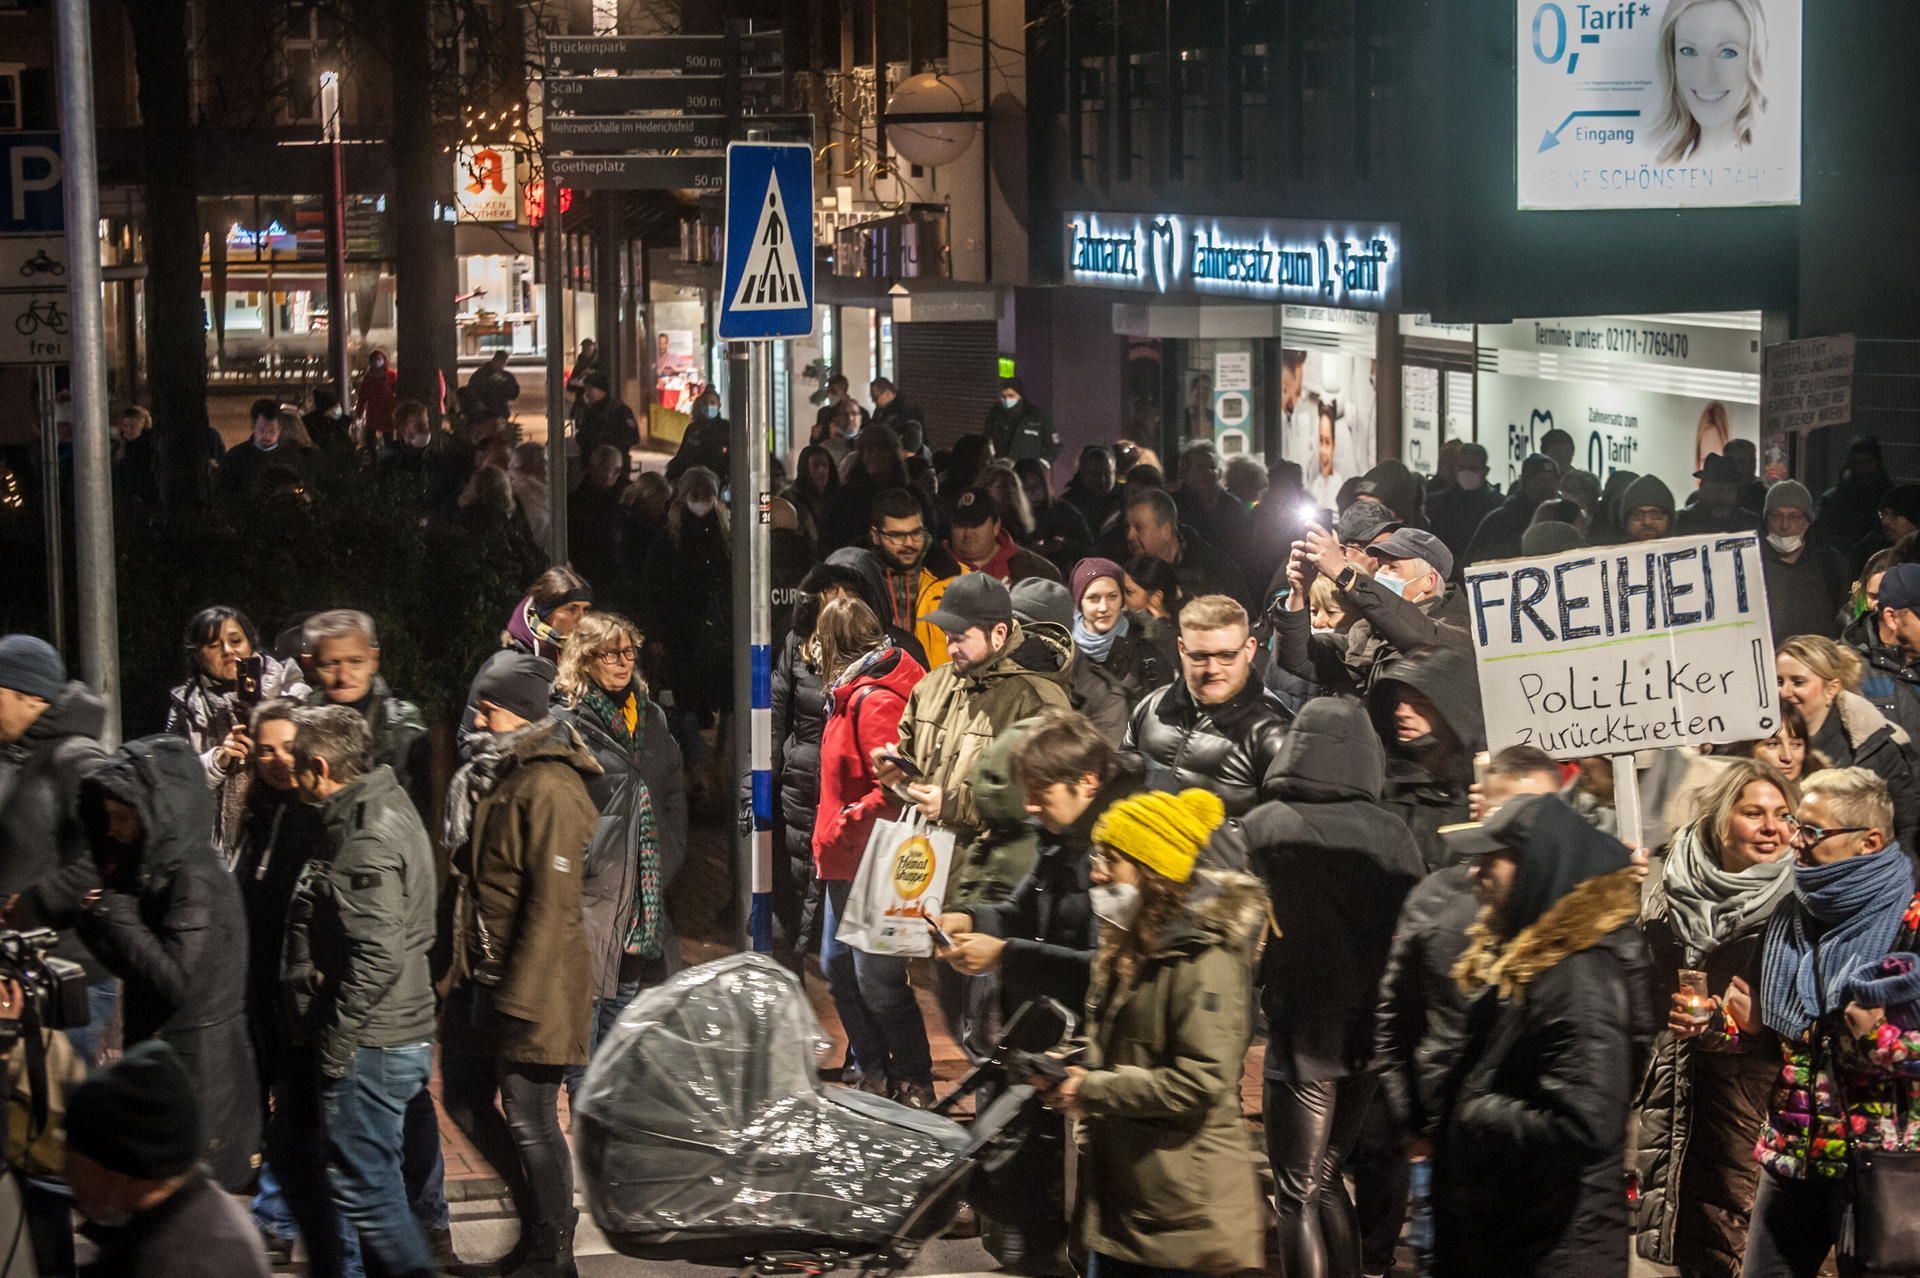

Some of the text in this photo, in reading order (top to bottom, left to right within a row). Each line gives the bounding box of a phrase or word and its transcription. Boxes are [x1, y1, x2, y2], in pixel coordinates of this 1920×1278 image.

[550, 41, 627, 54] Brückenpark
[686, 56, 722, 67] 500 m
[551, 82, 583, 94] Scala
[687, 96, 722, 107] 300 m
[551, 122, 620, 134] Mehrzweckhalle
[635, 121, 694, 133] Hederichsfeld
[694, 136, 723, 147] 90 m
[1576, 127, 1635, 145] Eingang
[552, 160, 626, 175] Goetheplatz
[9, 145, 63, 220] P
[694, 175, 723, 186] 50 m
[1600, 164, 1714, 190] SCHÖNSTEN
[1072, 222, 1138, 277] Zahnarzt
[1190, 231, 1273, 284] Zahnersatz
[1278, 250, 1314, 287] zum
[30, 340, 61, 355] frei
[1534, 322, 1689, 359] Termine unter: 02171-7769470
[1624, 415, 1639, 428] zum
[1509, 424, 1529, 461] Fair
[1464, 537, 1756, 647] FREIHEIT
